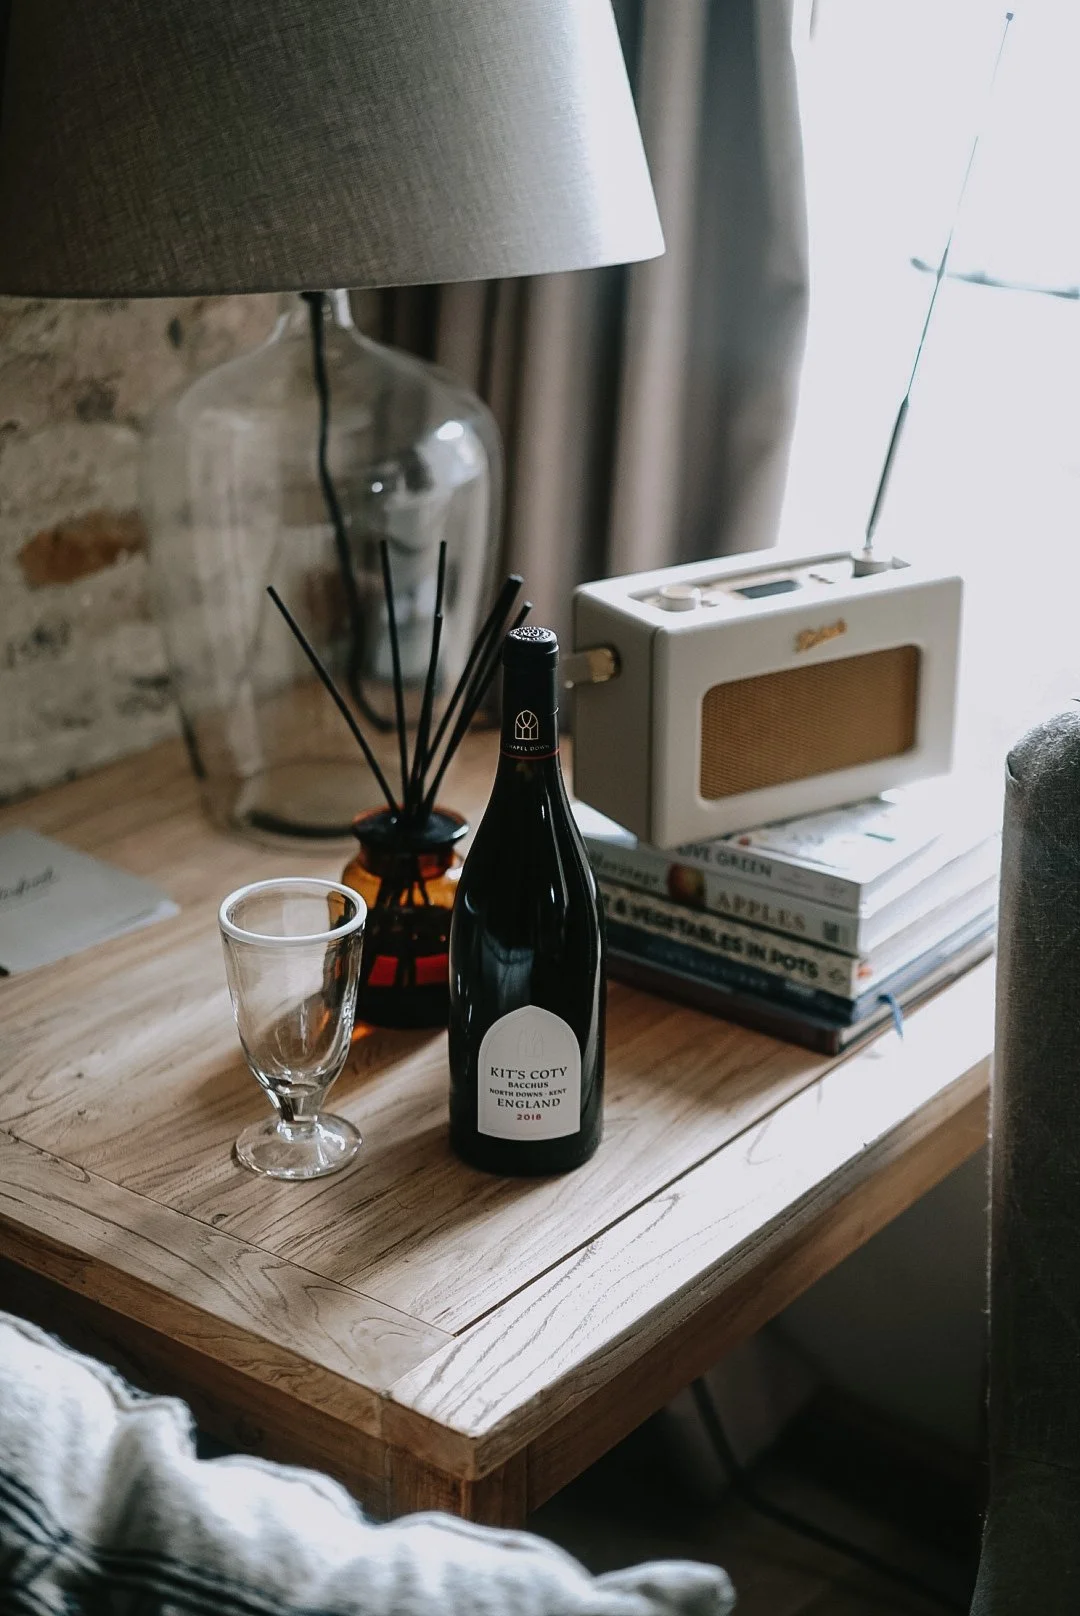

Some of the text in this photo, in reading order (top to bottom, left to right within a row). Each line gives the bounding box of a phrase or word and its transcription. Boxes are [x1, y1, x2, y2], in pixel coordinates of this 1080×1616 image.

[717, 850, 772, 878] GREEN
[717, 890, 806, 932] APPLES
[631, 903, 743, 953] VEGETABLES
[745, 942, 766, 961] IN
[768, 948, 820, 980] POTS
[490, 1066, 568, 1080] KIT'S COTY
[508, 1081, 549, 1089] BACCHUS
[489, 1087, 514, 1097] NORTH
[548, 1088, 567, 1096] KENT
[497, 1098, 561, 1109] ENGLAND
[516, 1113, 542, 1121] 2018
